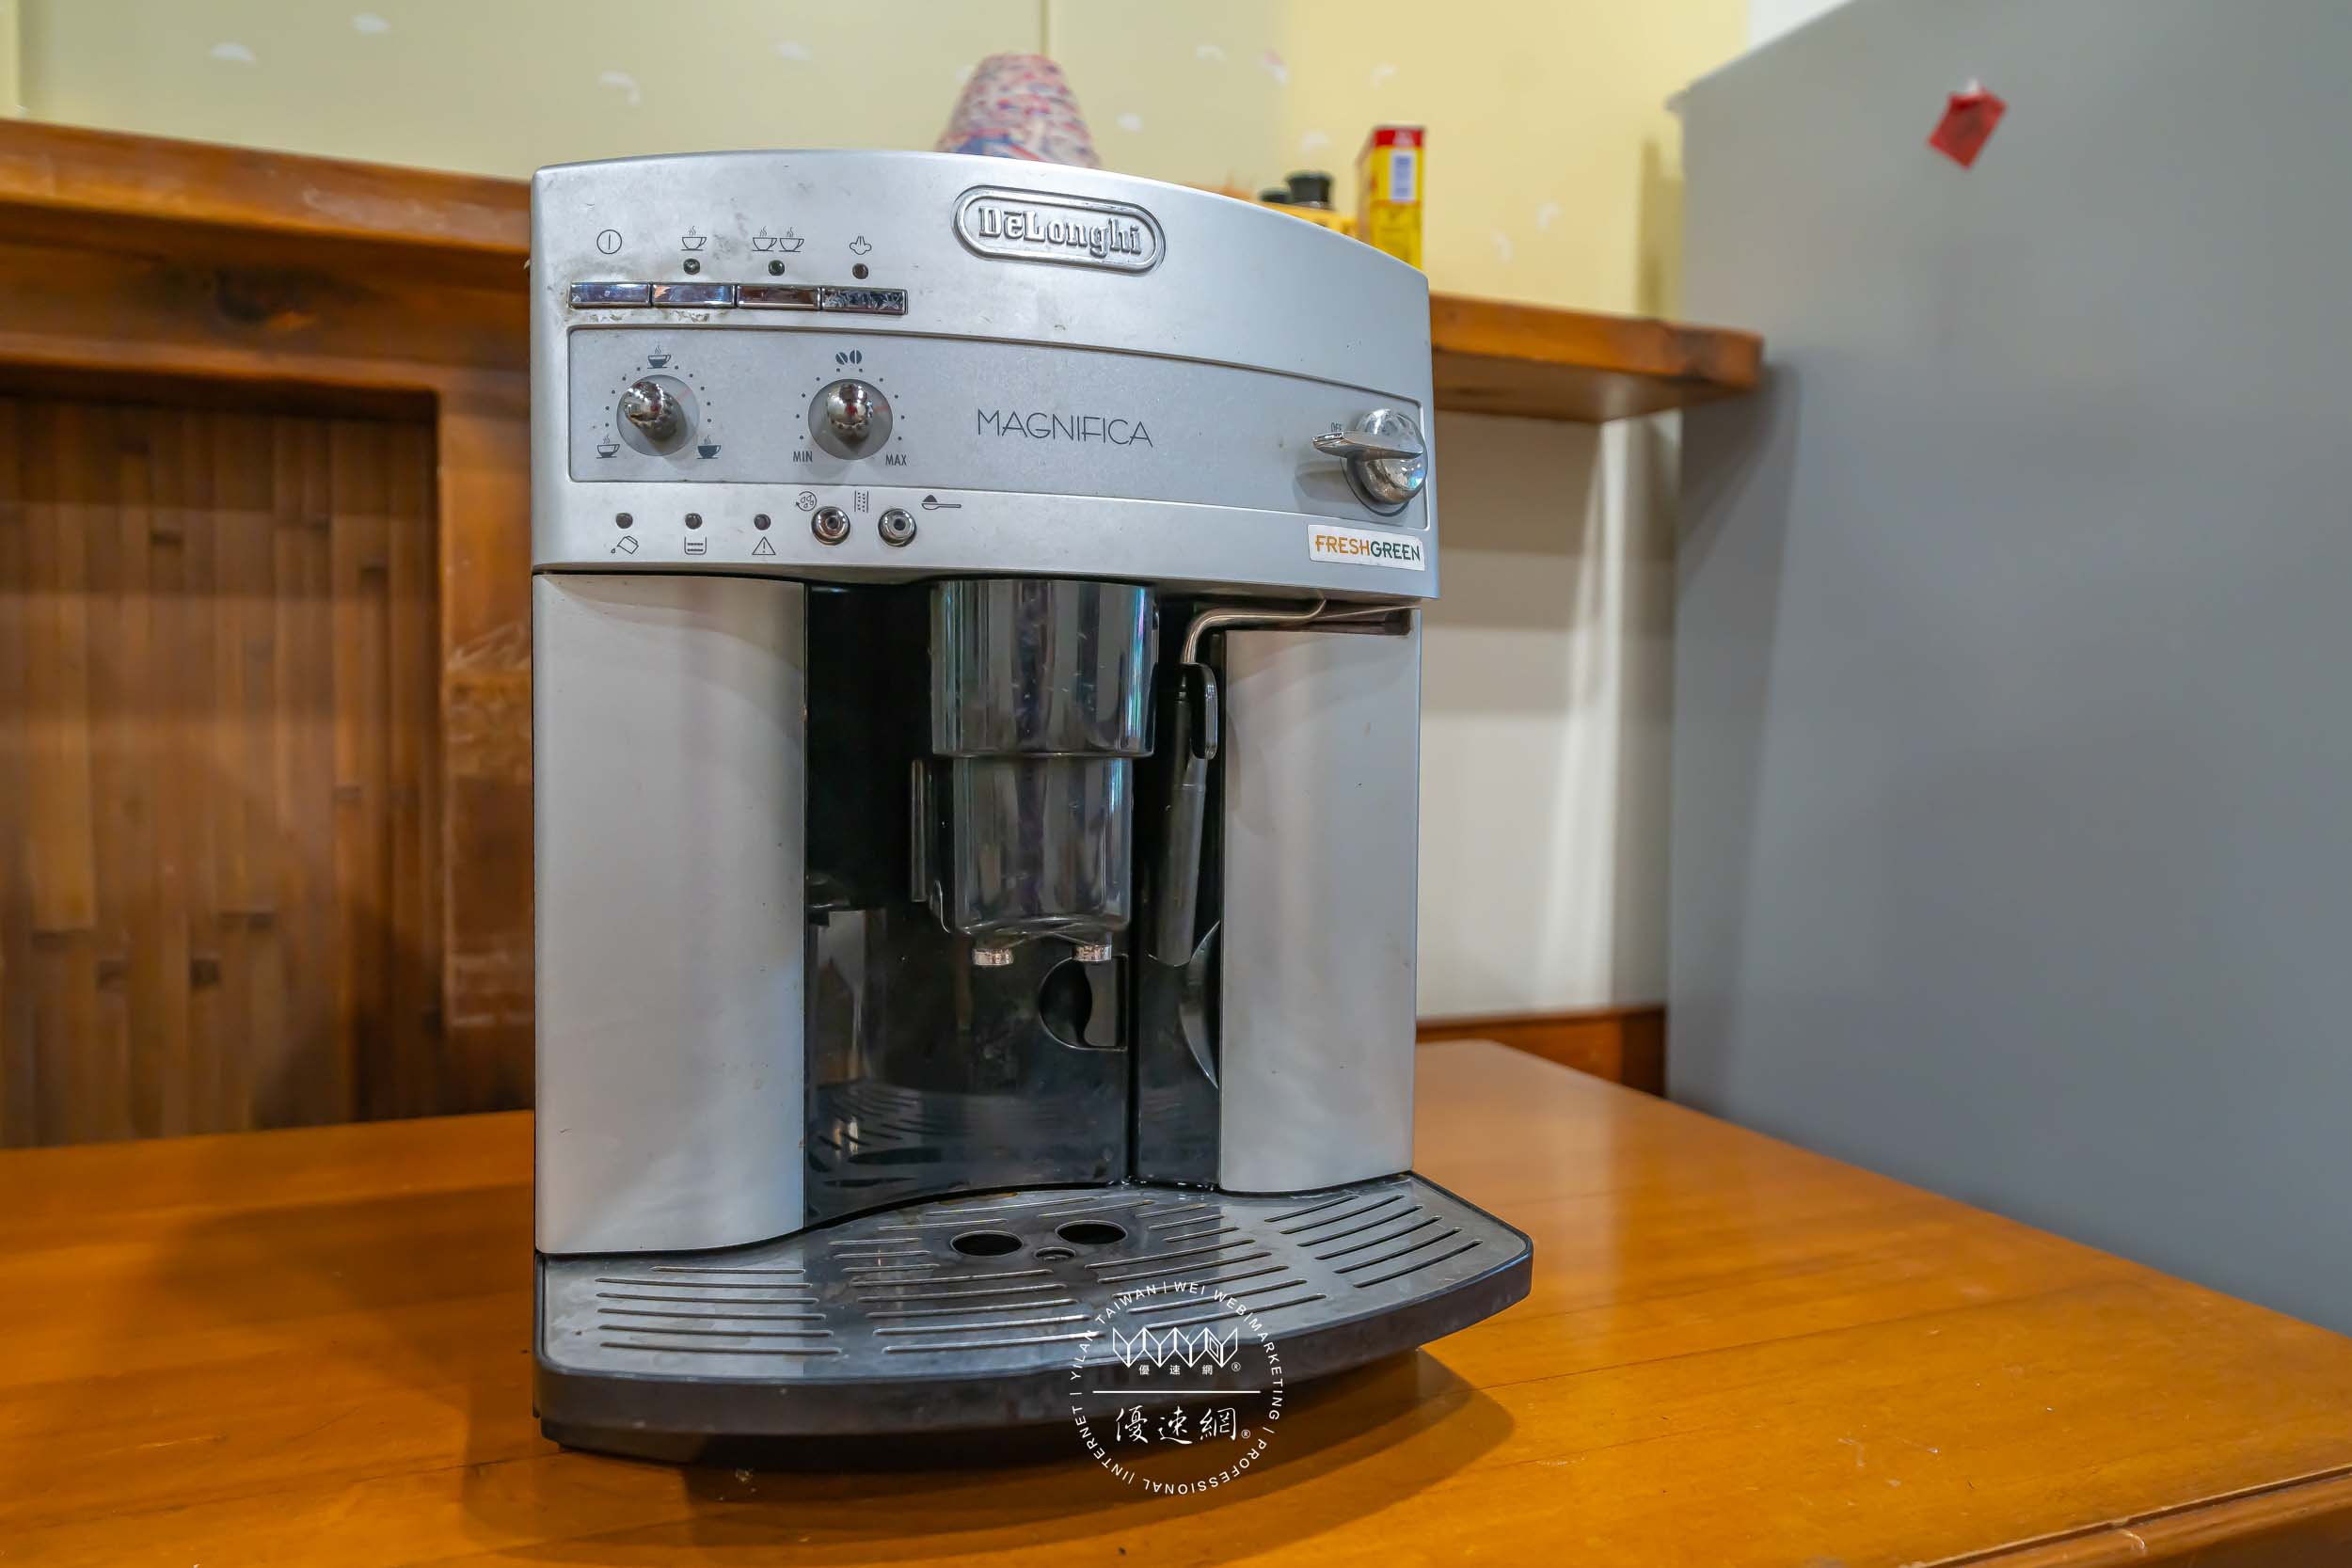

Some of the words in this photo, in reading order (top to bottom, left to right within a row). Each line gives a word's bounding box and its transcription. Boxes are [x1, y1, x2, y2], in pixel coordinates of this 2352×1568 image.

[977, 408, 1153, 448] MAGNIFICA
[792, 451, 813, 463] MIN
[884, 454, 907, 467] MAX
[1315, 534, 1421, 562] FRESHGREEN
